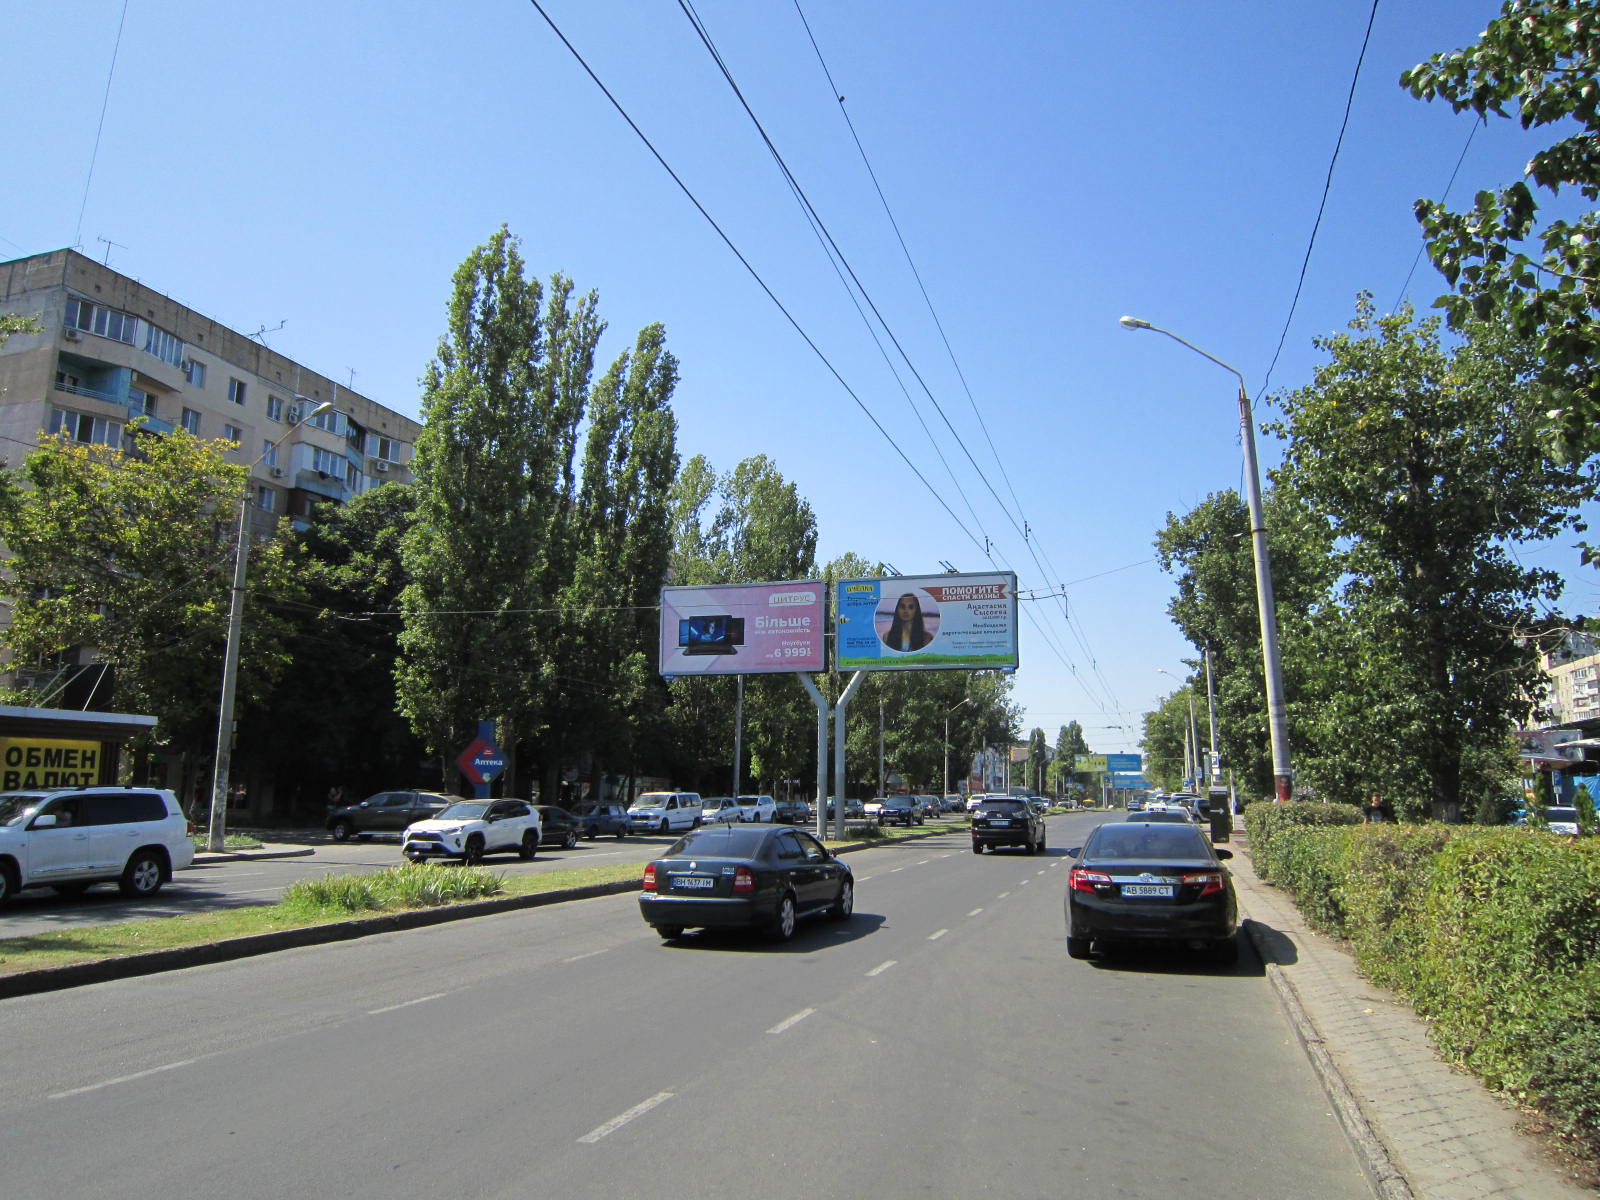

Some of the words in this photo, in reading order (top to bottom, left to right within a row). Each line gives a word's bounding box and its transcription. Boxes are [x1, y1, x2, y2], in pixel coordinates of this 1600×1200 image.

[942, 585, 999, 595] ПОМОГИТЕ
[972, 592, 1000, 600] ЖИЗНЬ!
[755, 616, 810, 628] Більше
[774, 648, 782, 657] 6
[5, 746, 96, 768] ОБМЕН
[474, 758, 503, 766] Аптека
[4, 771, 94, 790] ВАЛЮТ
[1126, 886, 1137, 895] AB
[1158, 886, 1170, 895] CT
